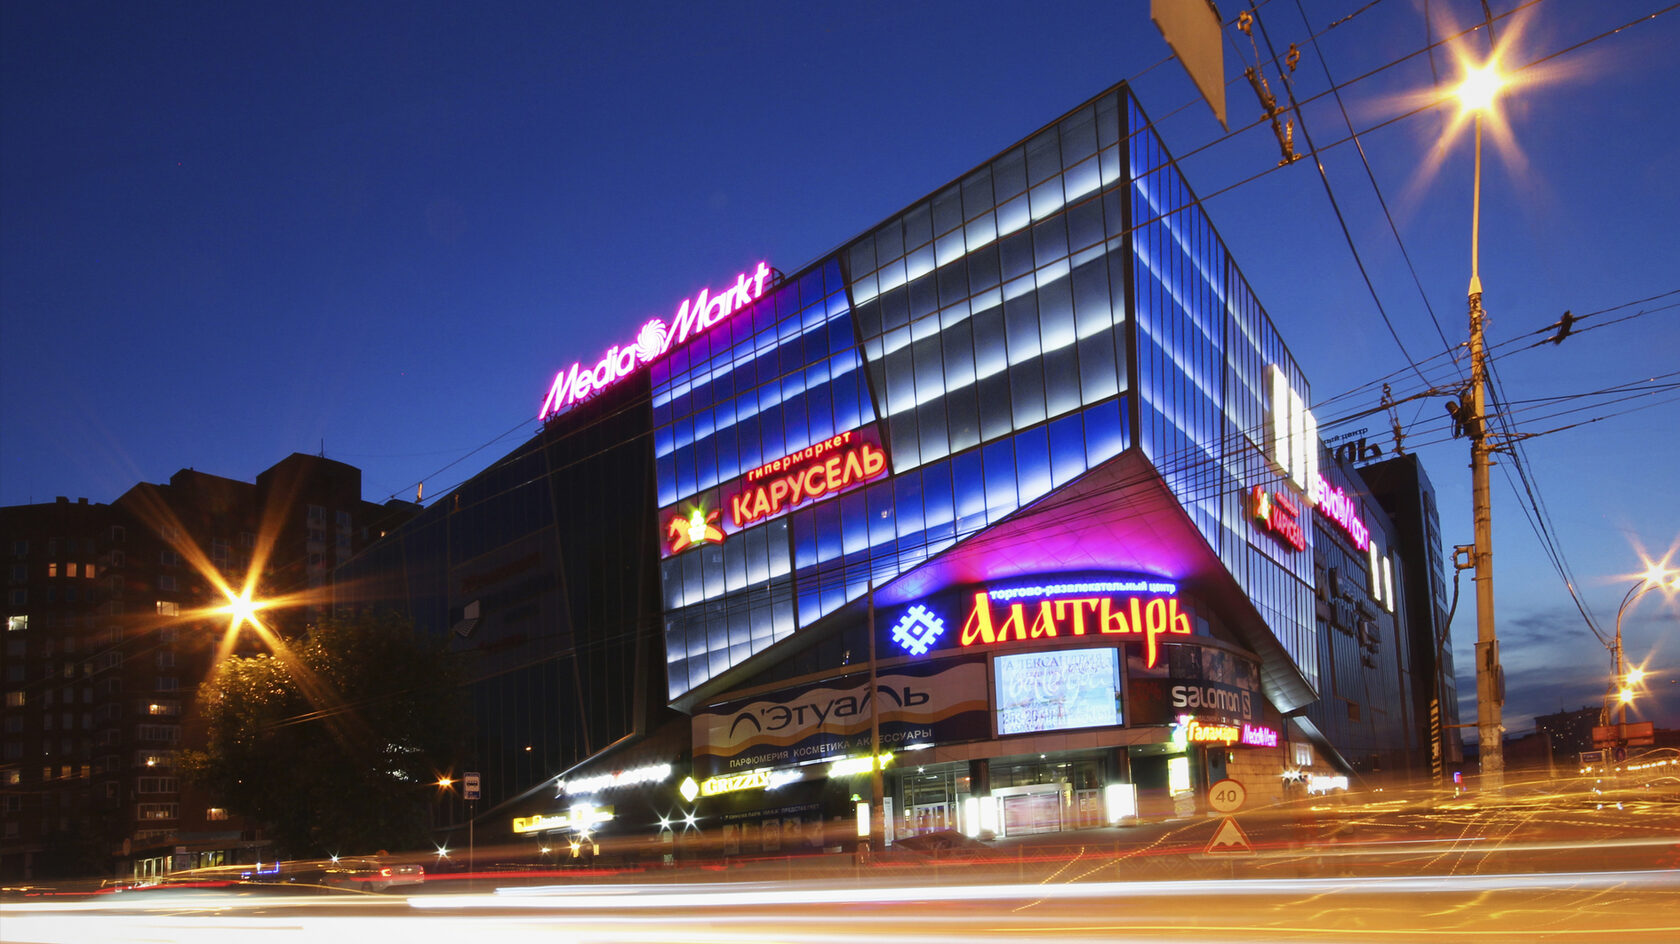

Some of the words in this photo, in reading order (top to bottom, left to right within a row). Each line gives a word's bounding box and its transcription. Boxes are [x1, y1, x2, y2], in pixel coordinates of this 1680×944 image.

[538, 344, 640, 420] Media
[661, 261, 770, 355] Markt
[748, 431, 851, 482] гипермаркет
[732, 444, 885, 526] КАРУСЕЛЬ
[989, 581, 1148, 601] торгово-развлекательный
[1149, 583, 1177, 596] центр
[962, 593, 1192, 669] Алатырь
[729, 685, 930, 739] Л'Этуаль
[729, 750, 789, 768] ПАРФЮМЕРИЯ
[793, 740, 850, 757] КОСМЕТИКА
[856, 728, 932, 747] АКЕССУАРЫ
[1215, 789, 1237, 803] 40
